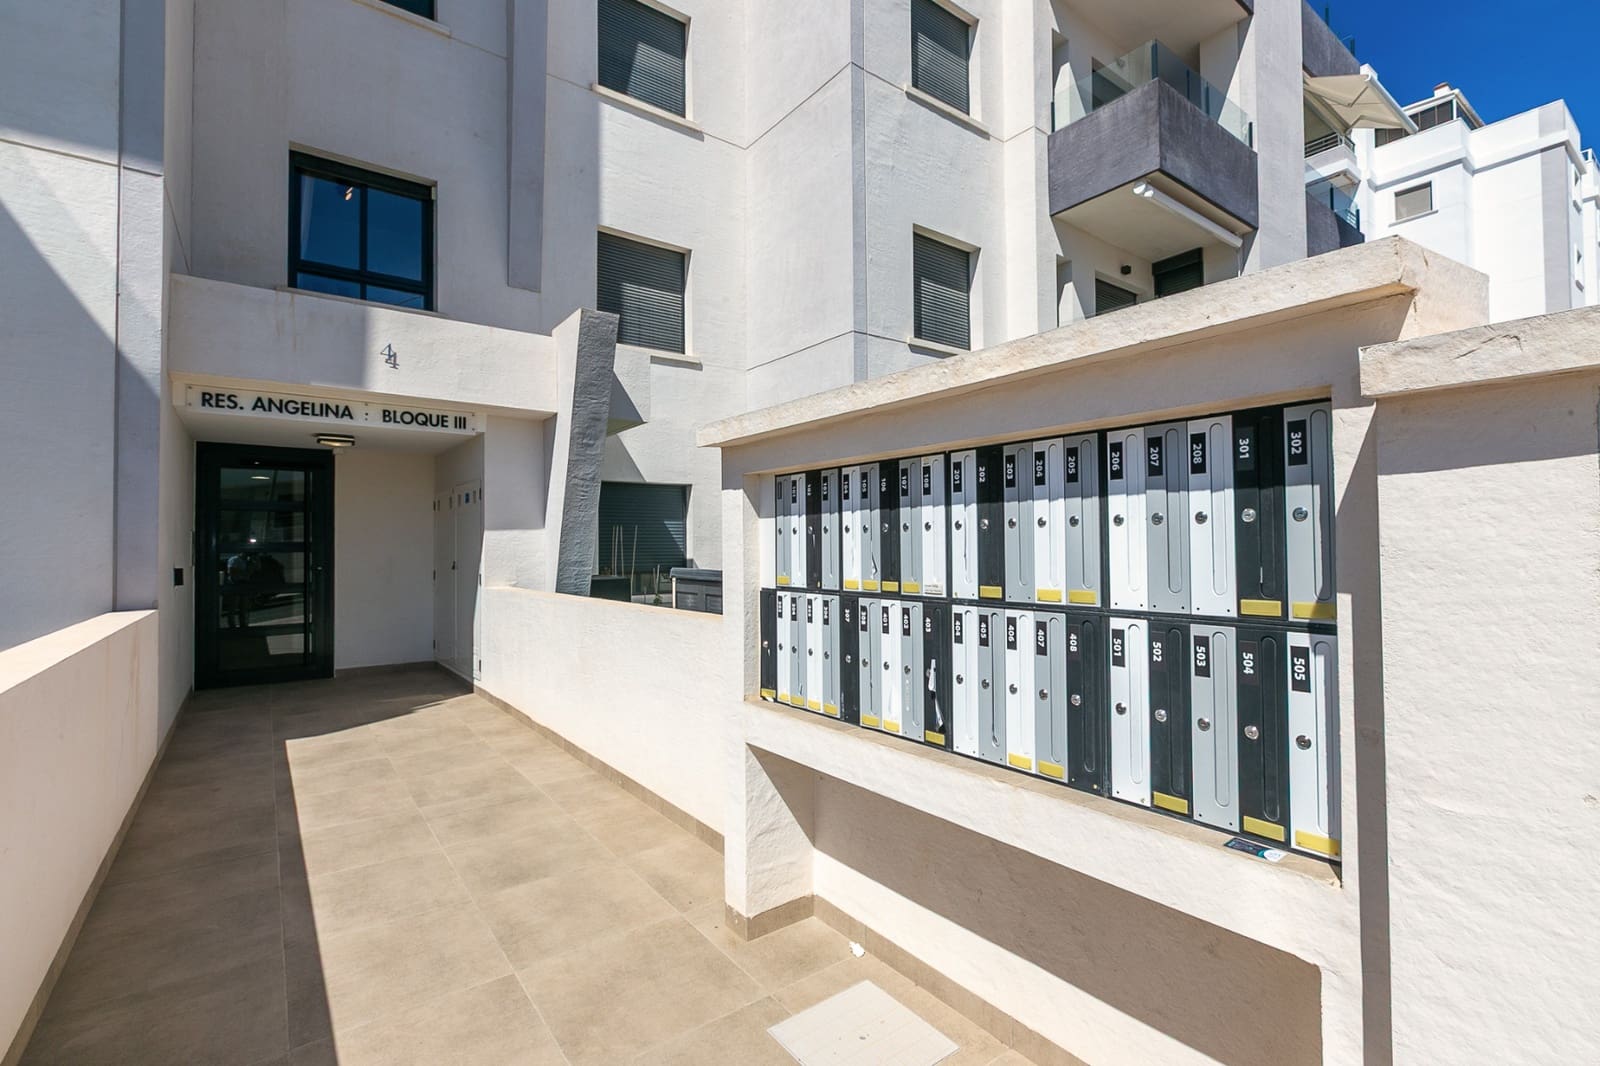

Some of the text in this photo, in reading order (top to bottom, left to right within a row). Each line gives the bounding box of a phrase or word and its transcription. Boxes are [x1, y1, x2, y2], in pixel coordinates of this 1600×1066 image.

[201, 391, 467, 430] RES. ANGELINA BLOQUE III
[1193, 443, 1202, 464] 208
[1239, 438, 1250, 459] 301
[1290, 431, 1302, 455] 302
[1068, 456, 1076, 474] 205
[1111, 452, 1120, 471] 206
[1150, 447, 1159, 466] 207
[978, 466, 986, 483] 202
[1037, 629, 1045, 647] 407
[1069, 633, 1077, 652] 408
[1113, 638, 1122, 657] 501
[1152, 641, 1162, 662] 502
[1196, 646, 1206, 667] 503
[1242, 652, 1254, 675] 504
[1293, 657, 1305, 681] 505
